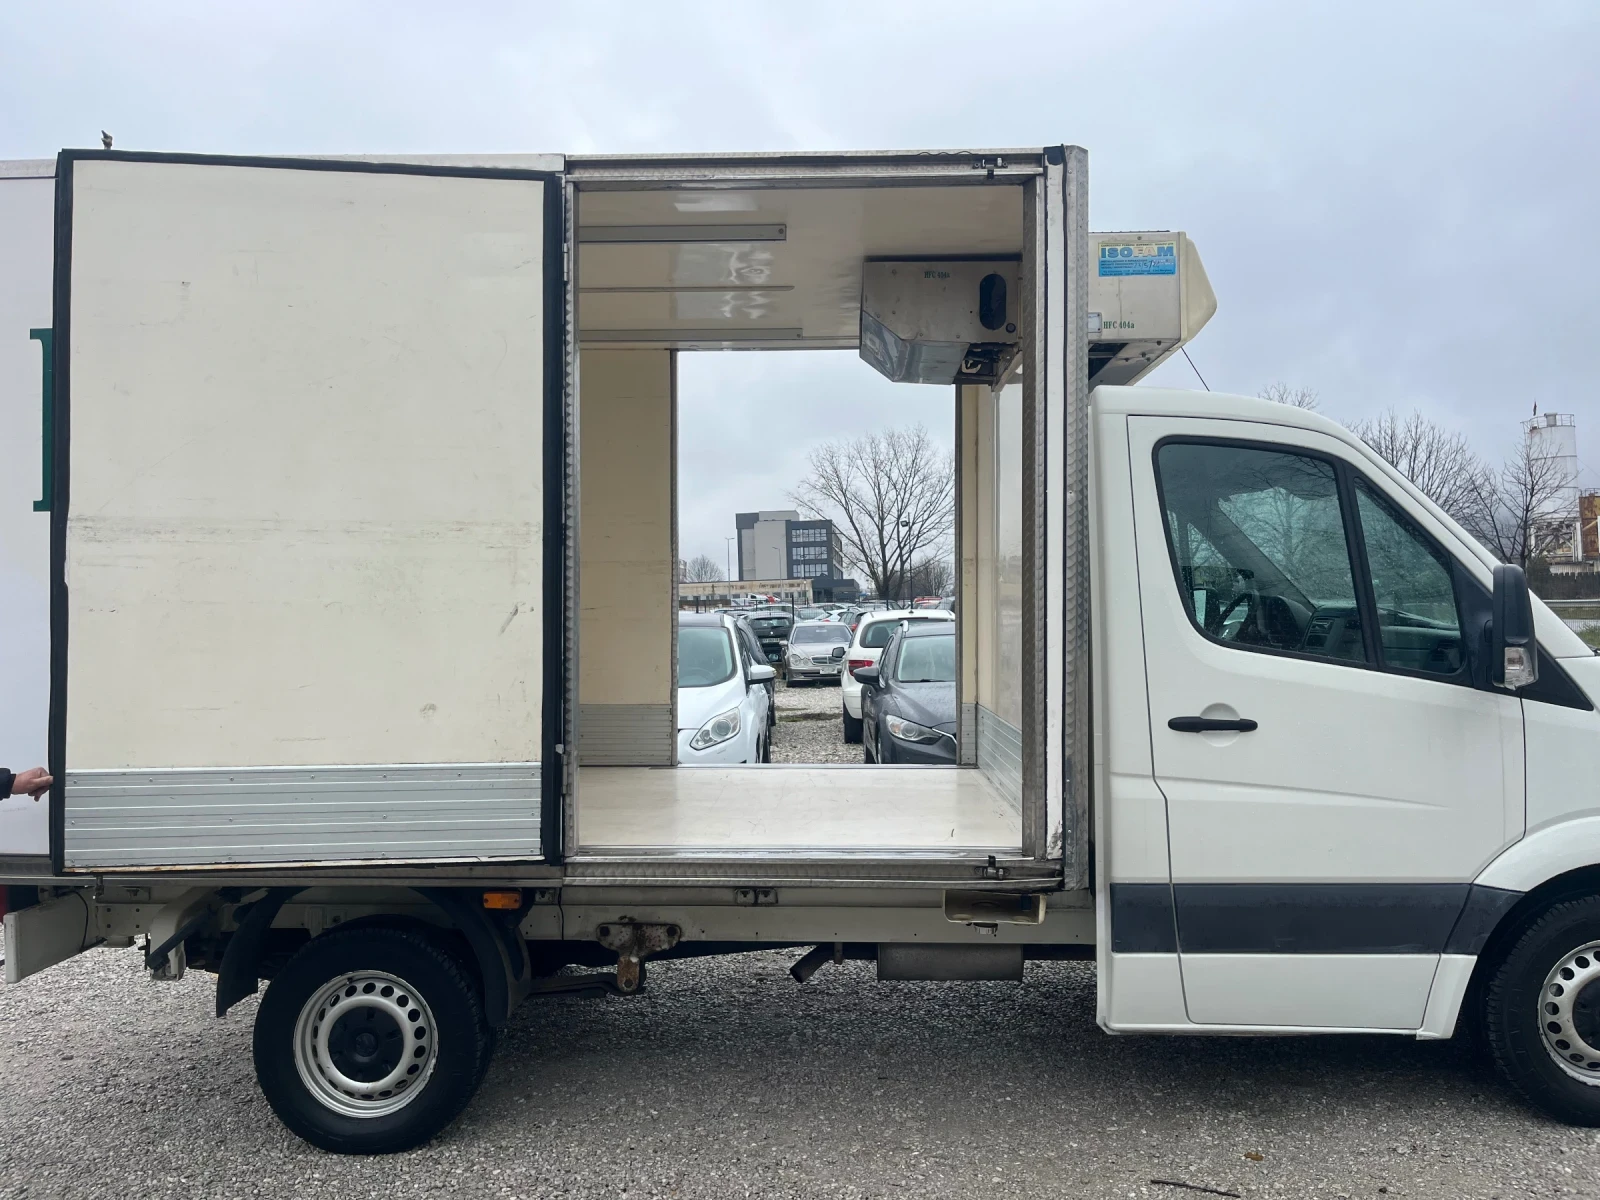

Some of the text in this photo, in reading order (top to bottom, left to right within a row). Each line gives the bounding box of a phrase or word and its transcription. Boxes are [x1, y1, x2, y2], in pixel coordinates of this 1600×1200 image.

[1101, 246, 1174, 258] ISOFAM
[1103, 320, 1135, 329] HFC 404a
